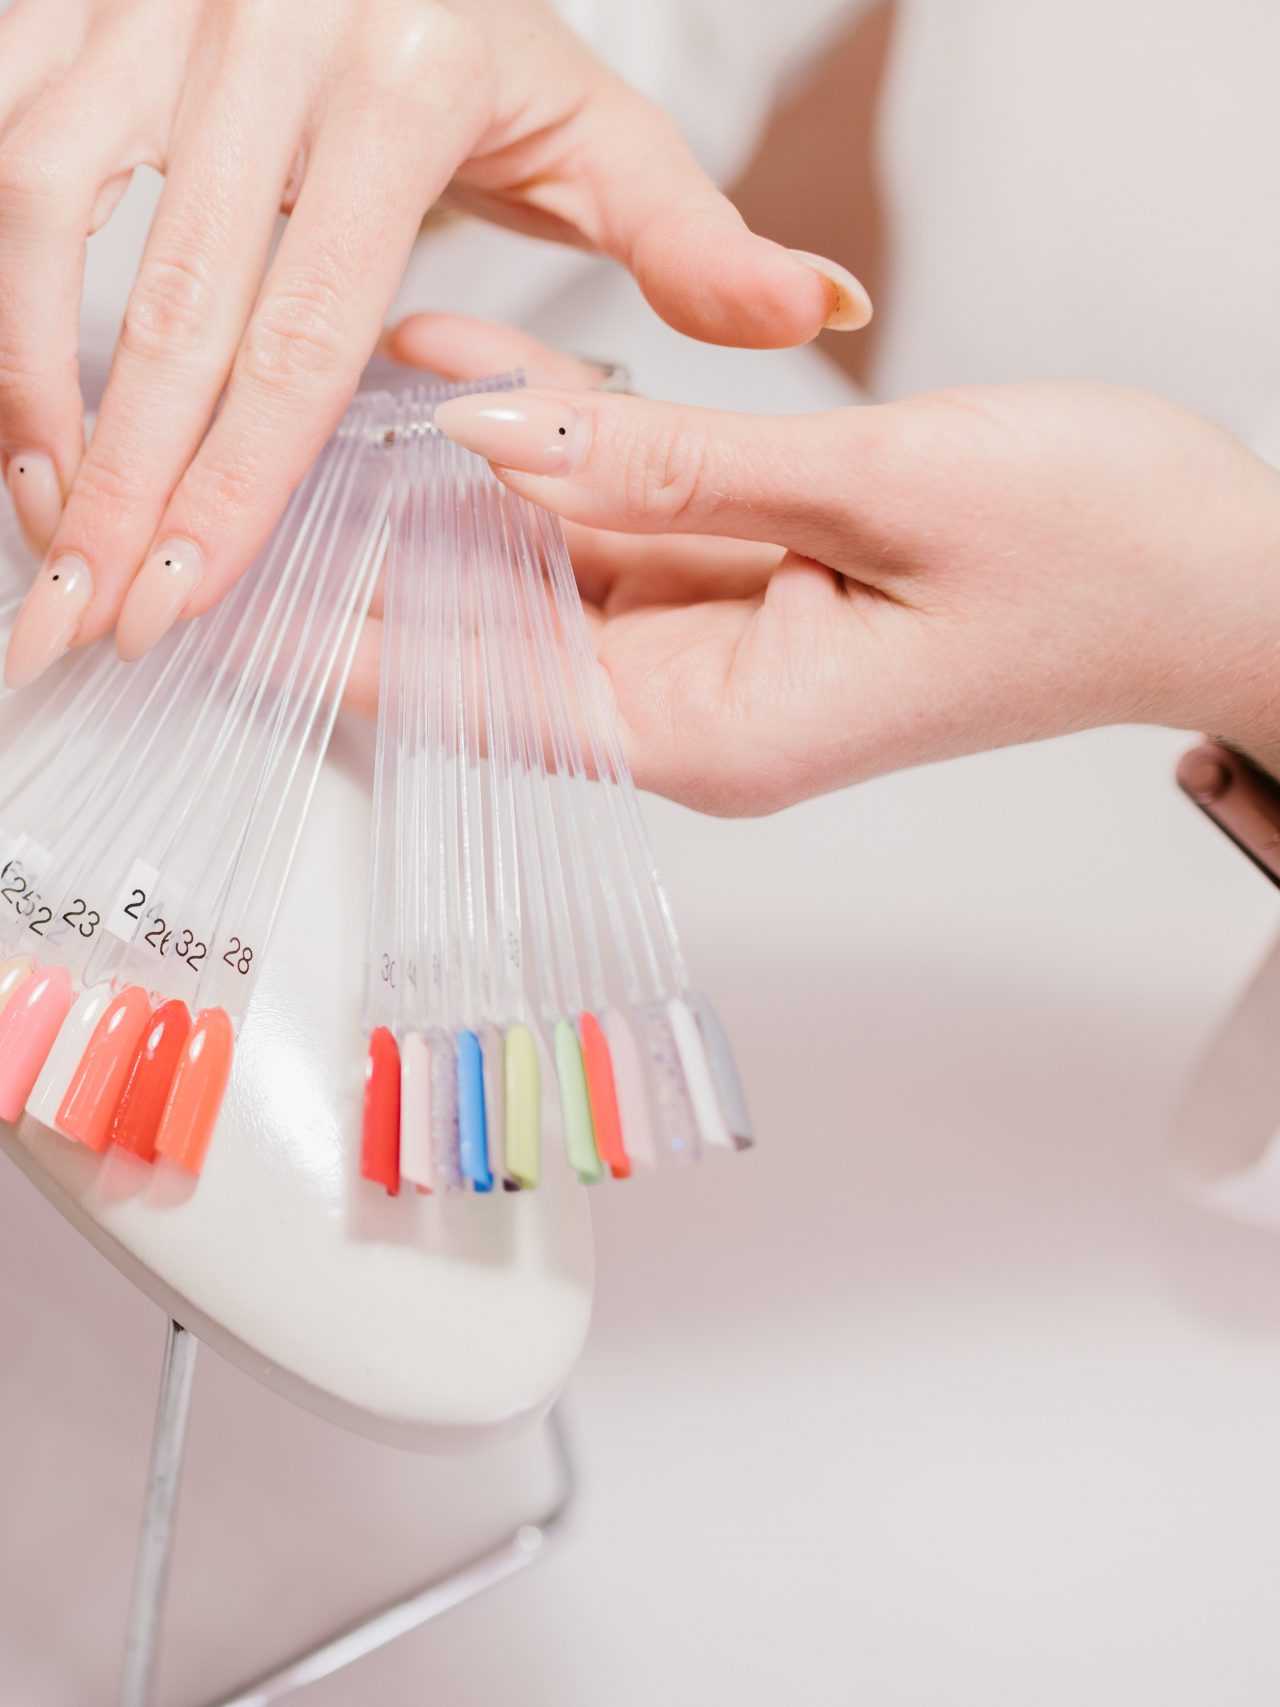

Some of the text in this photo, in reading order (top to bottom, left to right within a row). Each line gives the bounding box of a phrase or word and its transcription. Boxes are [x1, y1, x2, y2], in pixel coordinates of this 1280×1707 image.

[62, 898, 100, 937] 23
[175, 929, 207, 972] 32
[223, 936, 253, 975] 28
